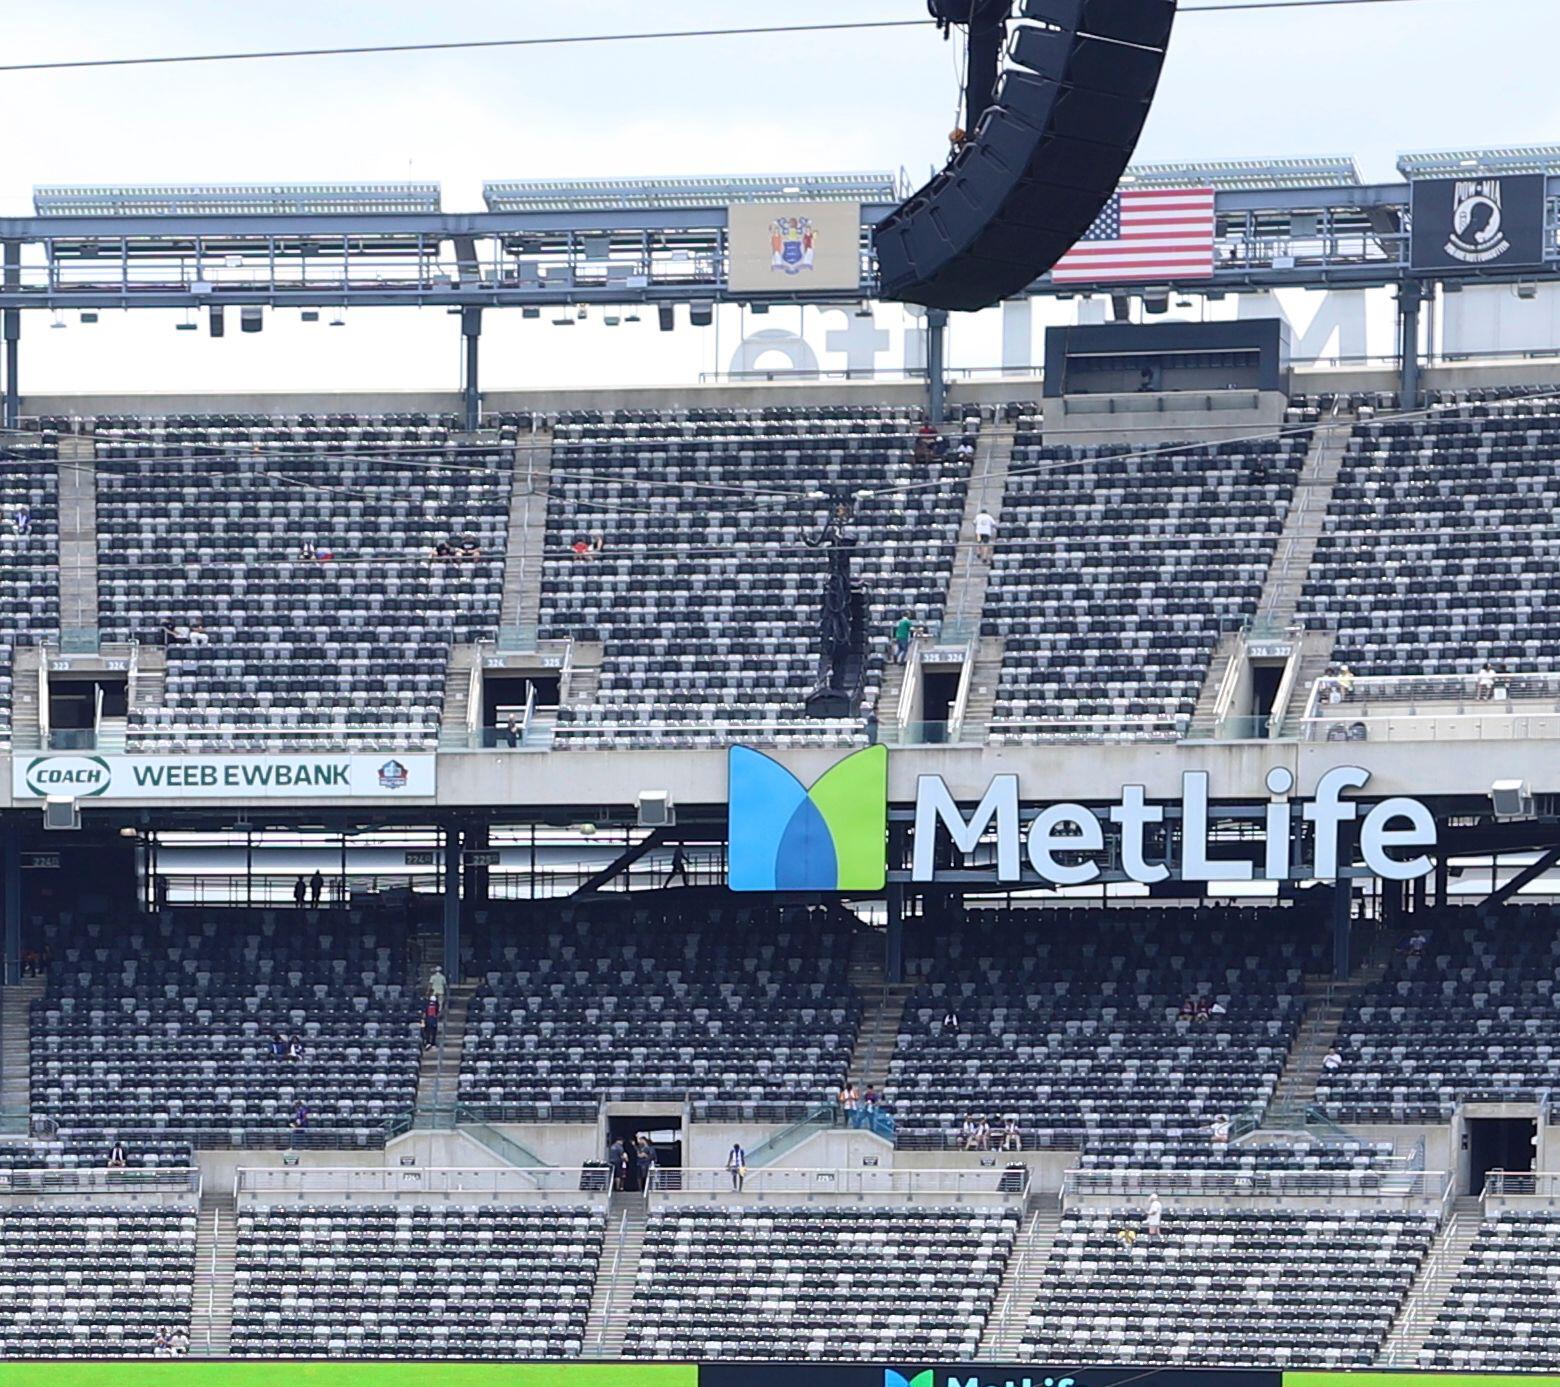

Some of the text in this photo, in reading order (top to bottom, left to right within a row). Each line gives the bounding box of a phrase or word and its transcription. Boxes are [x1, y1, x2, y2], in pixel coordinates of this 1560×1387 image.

[36, 767, 101, 785] COACH
[134, 764, 351, 787] WEEB EWBANK
[913, 765, 1439, 886] MetLife
